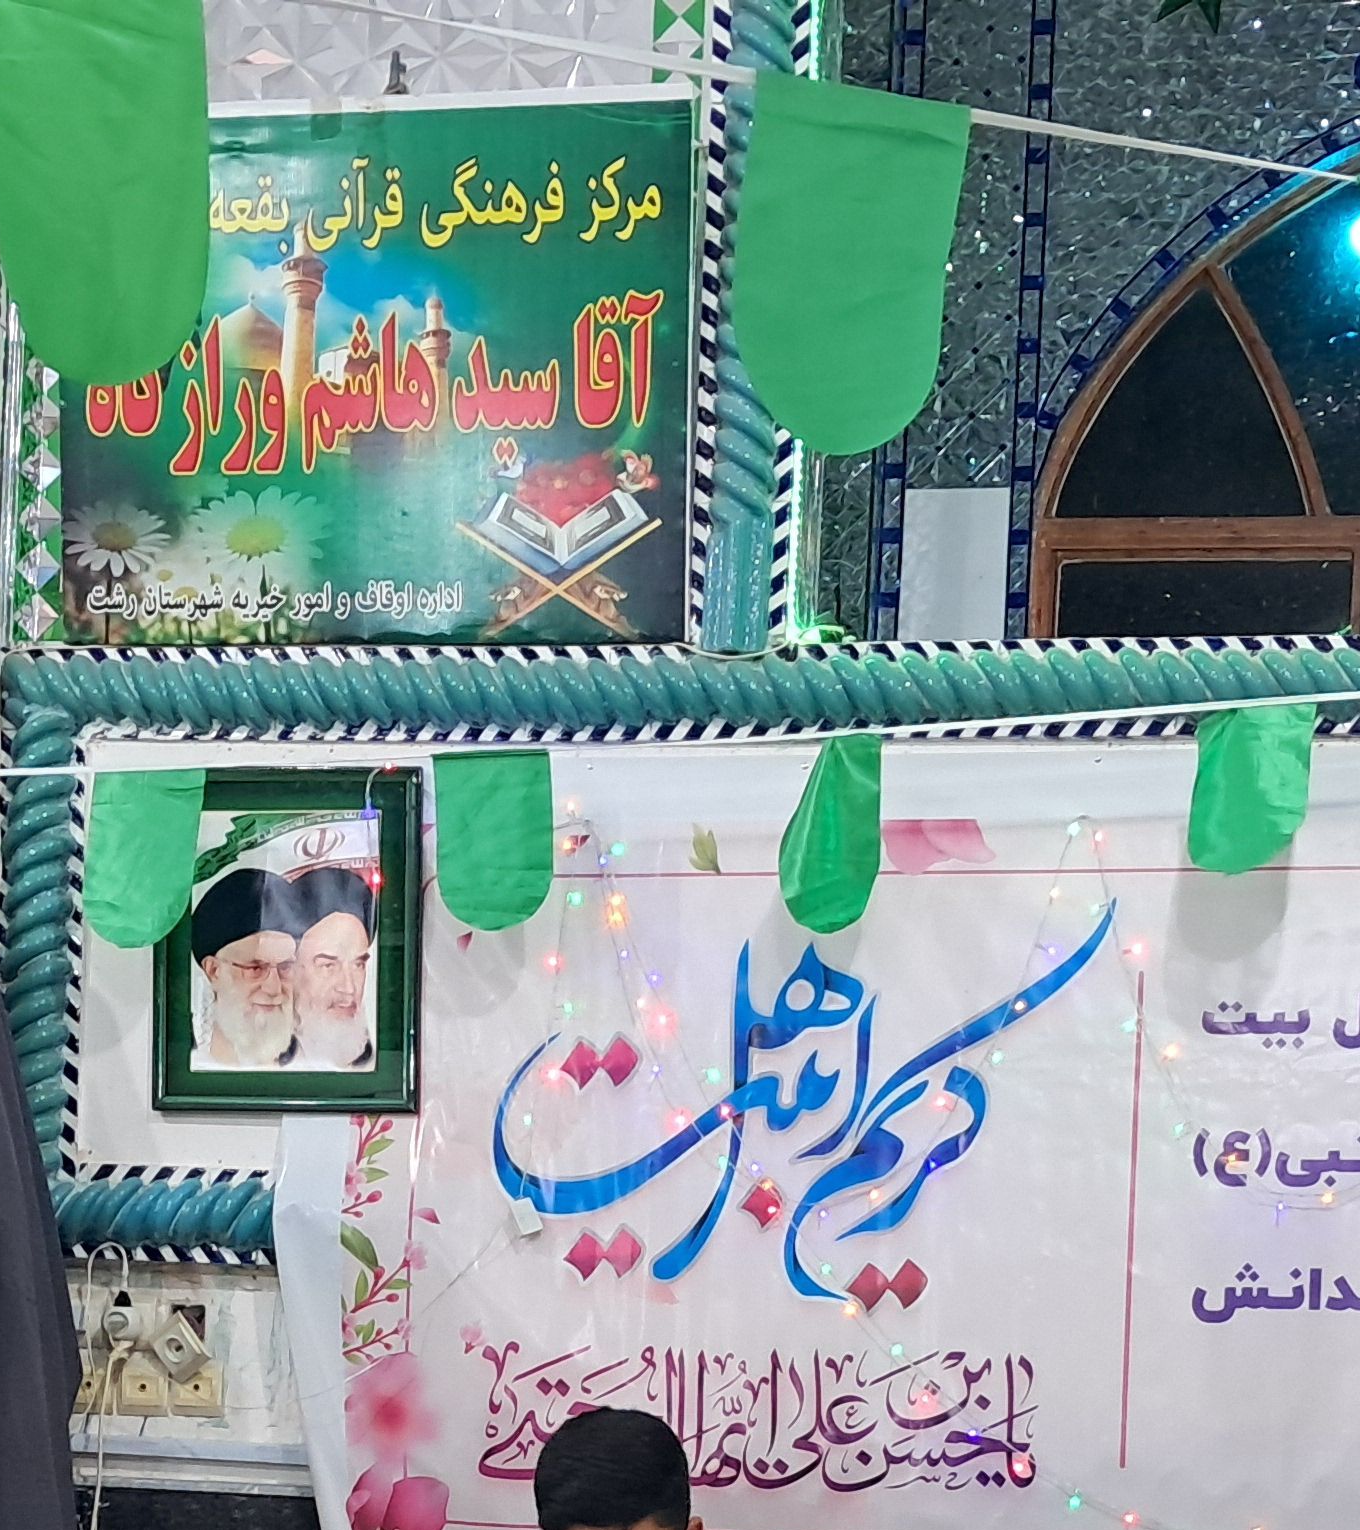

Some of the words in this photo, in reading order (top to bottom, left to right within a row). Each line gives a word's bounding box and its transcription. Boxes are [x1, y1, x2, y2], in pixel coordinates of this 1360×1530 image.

[305, 156, 403, 250] قرآنی
[421, 156, 565, 250] فرهنگی
[579, 156, 662, 244] مرکز
[573, 290, 664, 430] آقا
[300, 311, 439, 476] هاشم
[452, 336, 560, 466] سید
[87, 582, 135, 618] رشت
[141, 581, 223, 618] شهرستان
[232, 584, 285, 617] خیریه
[290, 582, 332, 617] امور
[335, 596, 349, 617] و
[355, 581, 414, 616] اوقاف
[421, 582, 464, 613] اداره
[1199, 993, 1311, 1048] بیت
